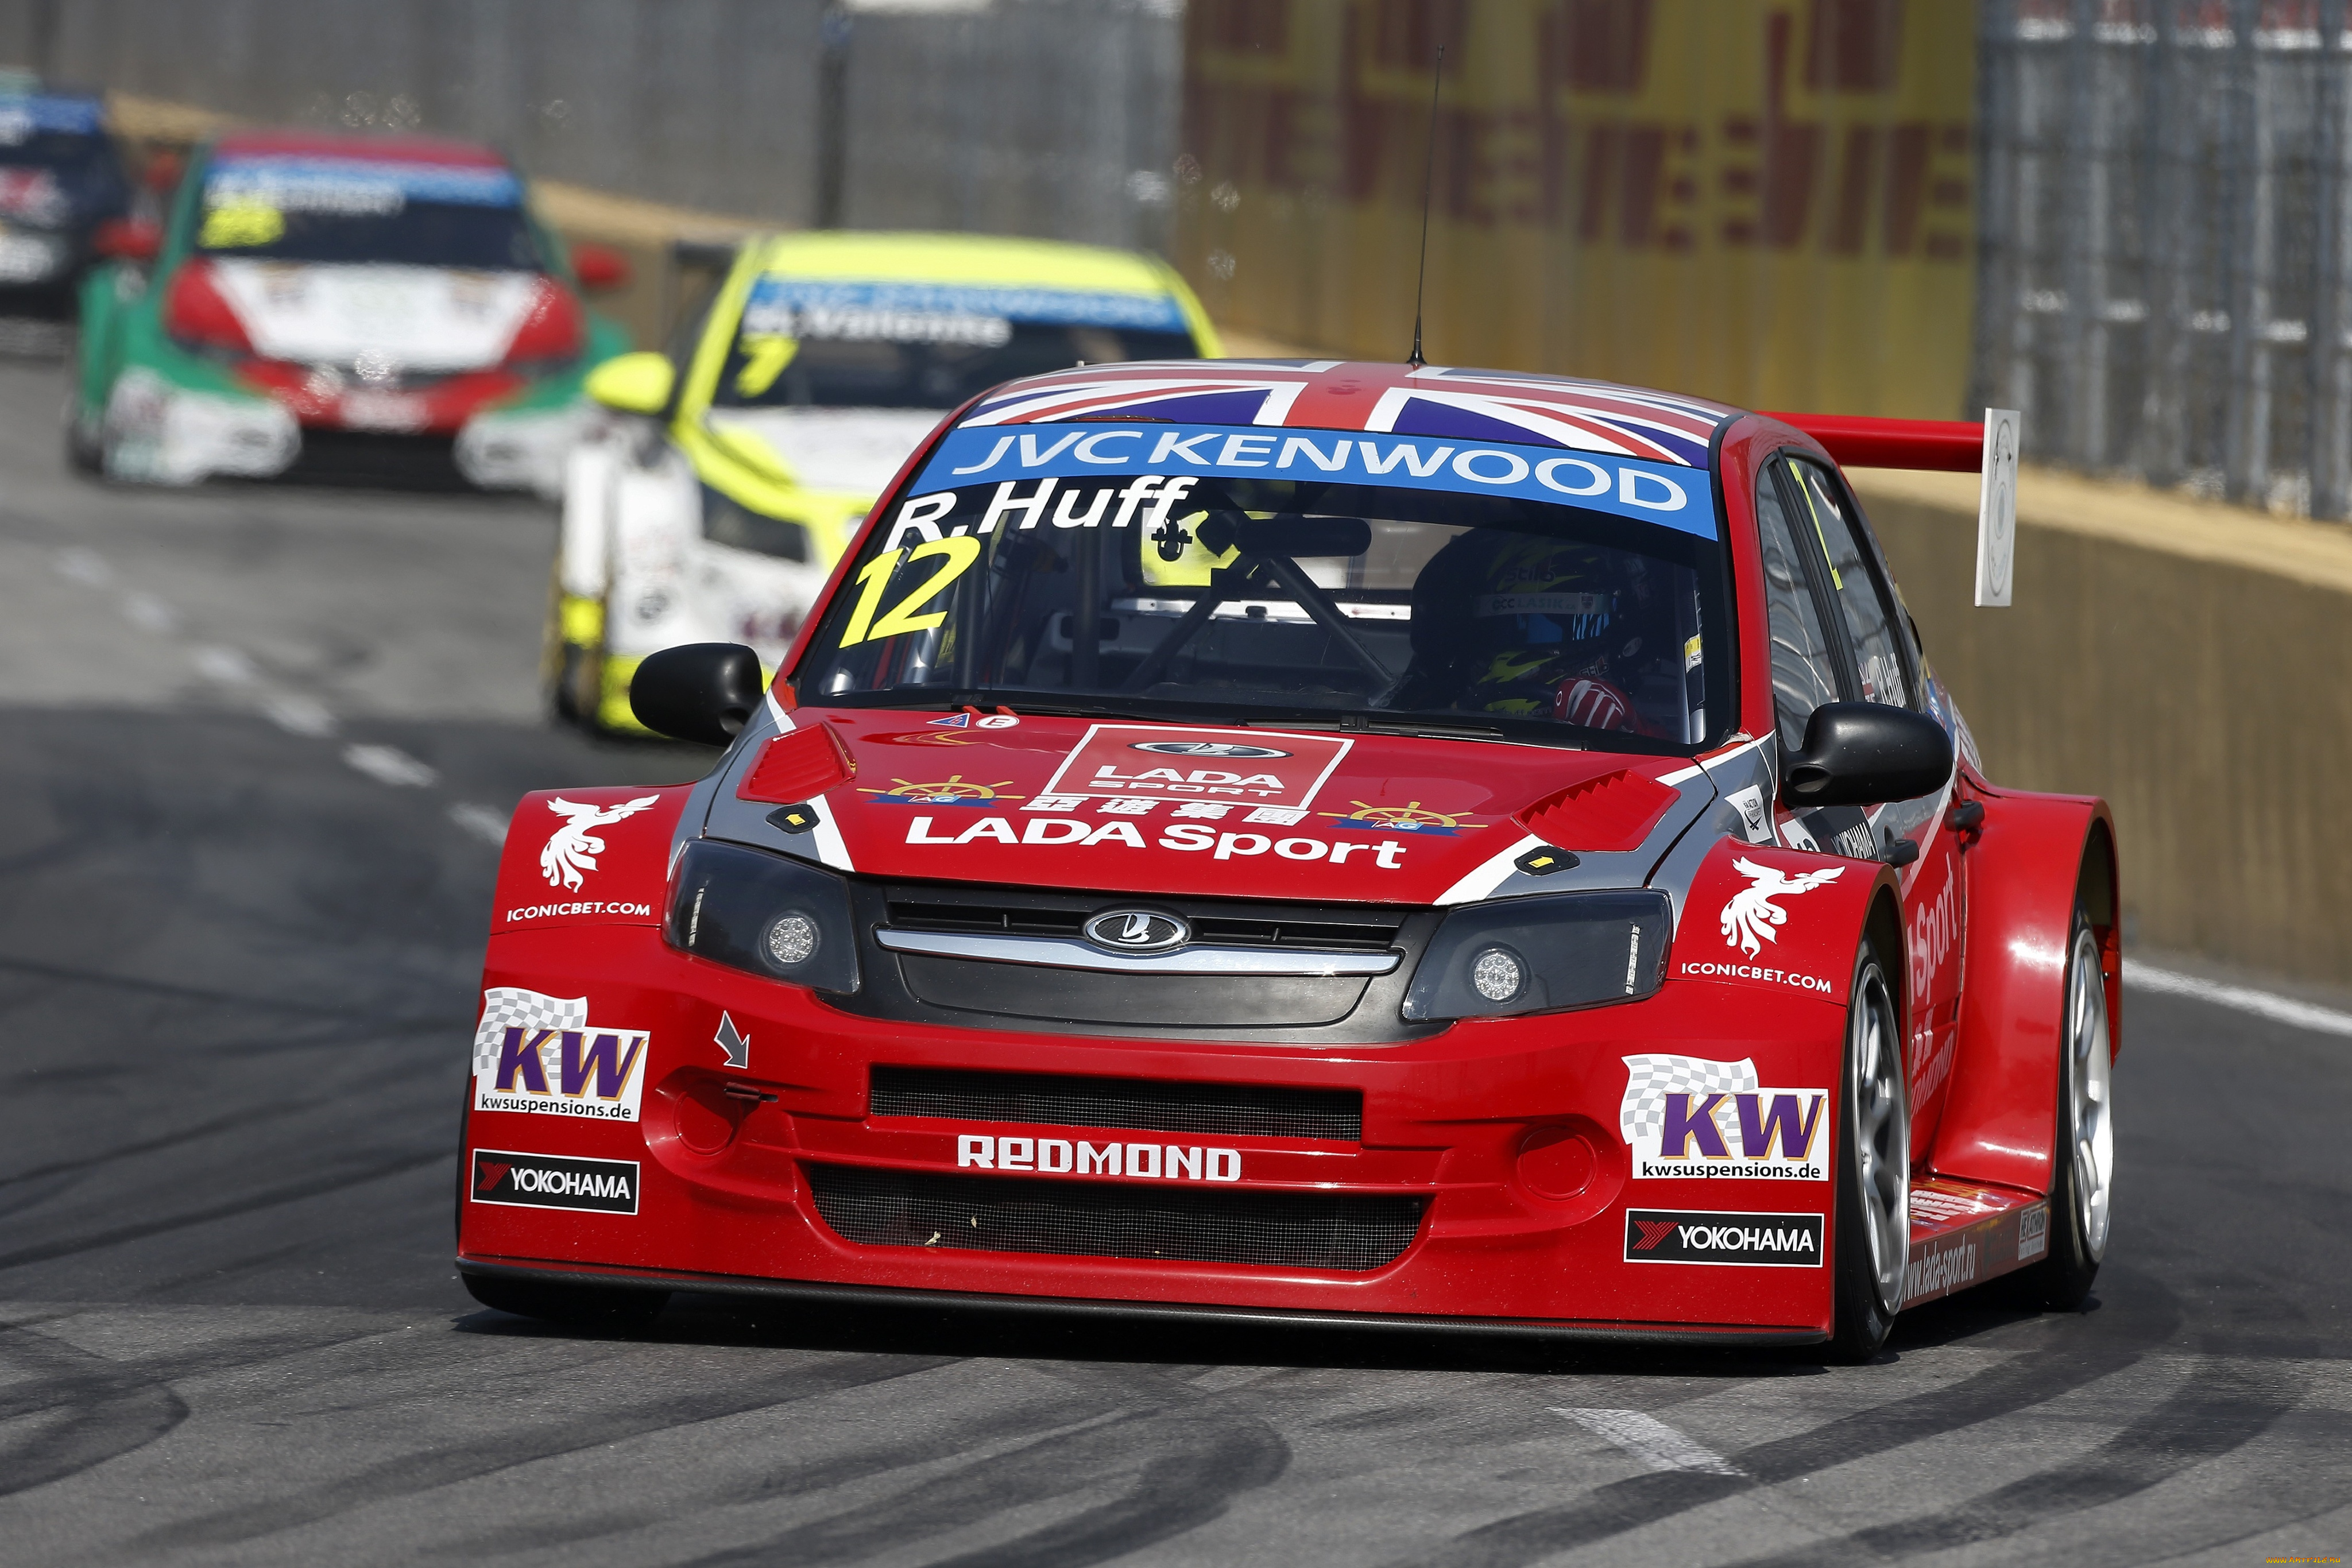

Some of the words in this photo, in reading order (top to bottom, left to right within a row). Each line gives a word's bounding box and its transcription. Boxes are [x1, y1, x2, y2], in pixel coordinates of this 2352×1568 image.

[883, 475, 1198, 554] R.Huff
[840, 536, 981, 648] 12
[1088, 780, 1282, 797] SPORT
[1094, 765, 1285, 789] LADA
[1019, 795, 1312, 826] 亞遊集團
[905, 816, 1147, 848] LADA
[1158, 823, 1407, 869] Sport
[506, 902, 650, 922] ICONICBET.COM
[1681, 962, 1832, 994] ICONICBET.COM
[496, 1027, 646, 1101] KW
[481, 1094, 632, 1120] kwsuspensions.de
[1661, 1093, 1826, 1161] KW
[510, 1168, 630, 1199] YOKOHAMA
[1642, 1161, 1821, 1180] kwsuspensions.de
[1678, 1225, 1814, 1252] YOKOHAMA
[1904, 1233, 1976, 1302] ww.lada-sport.ru
